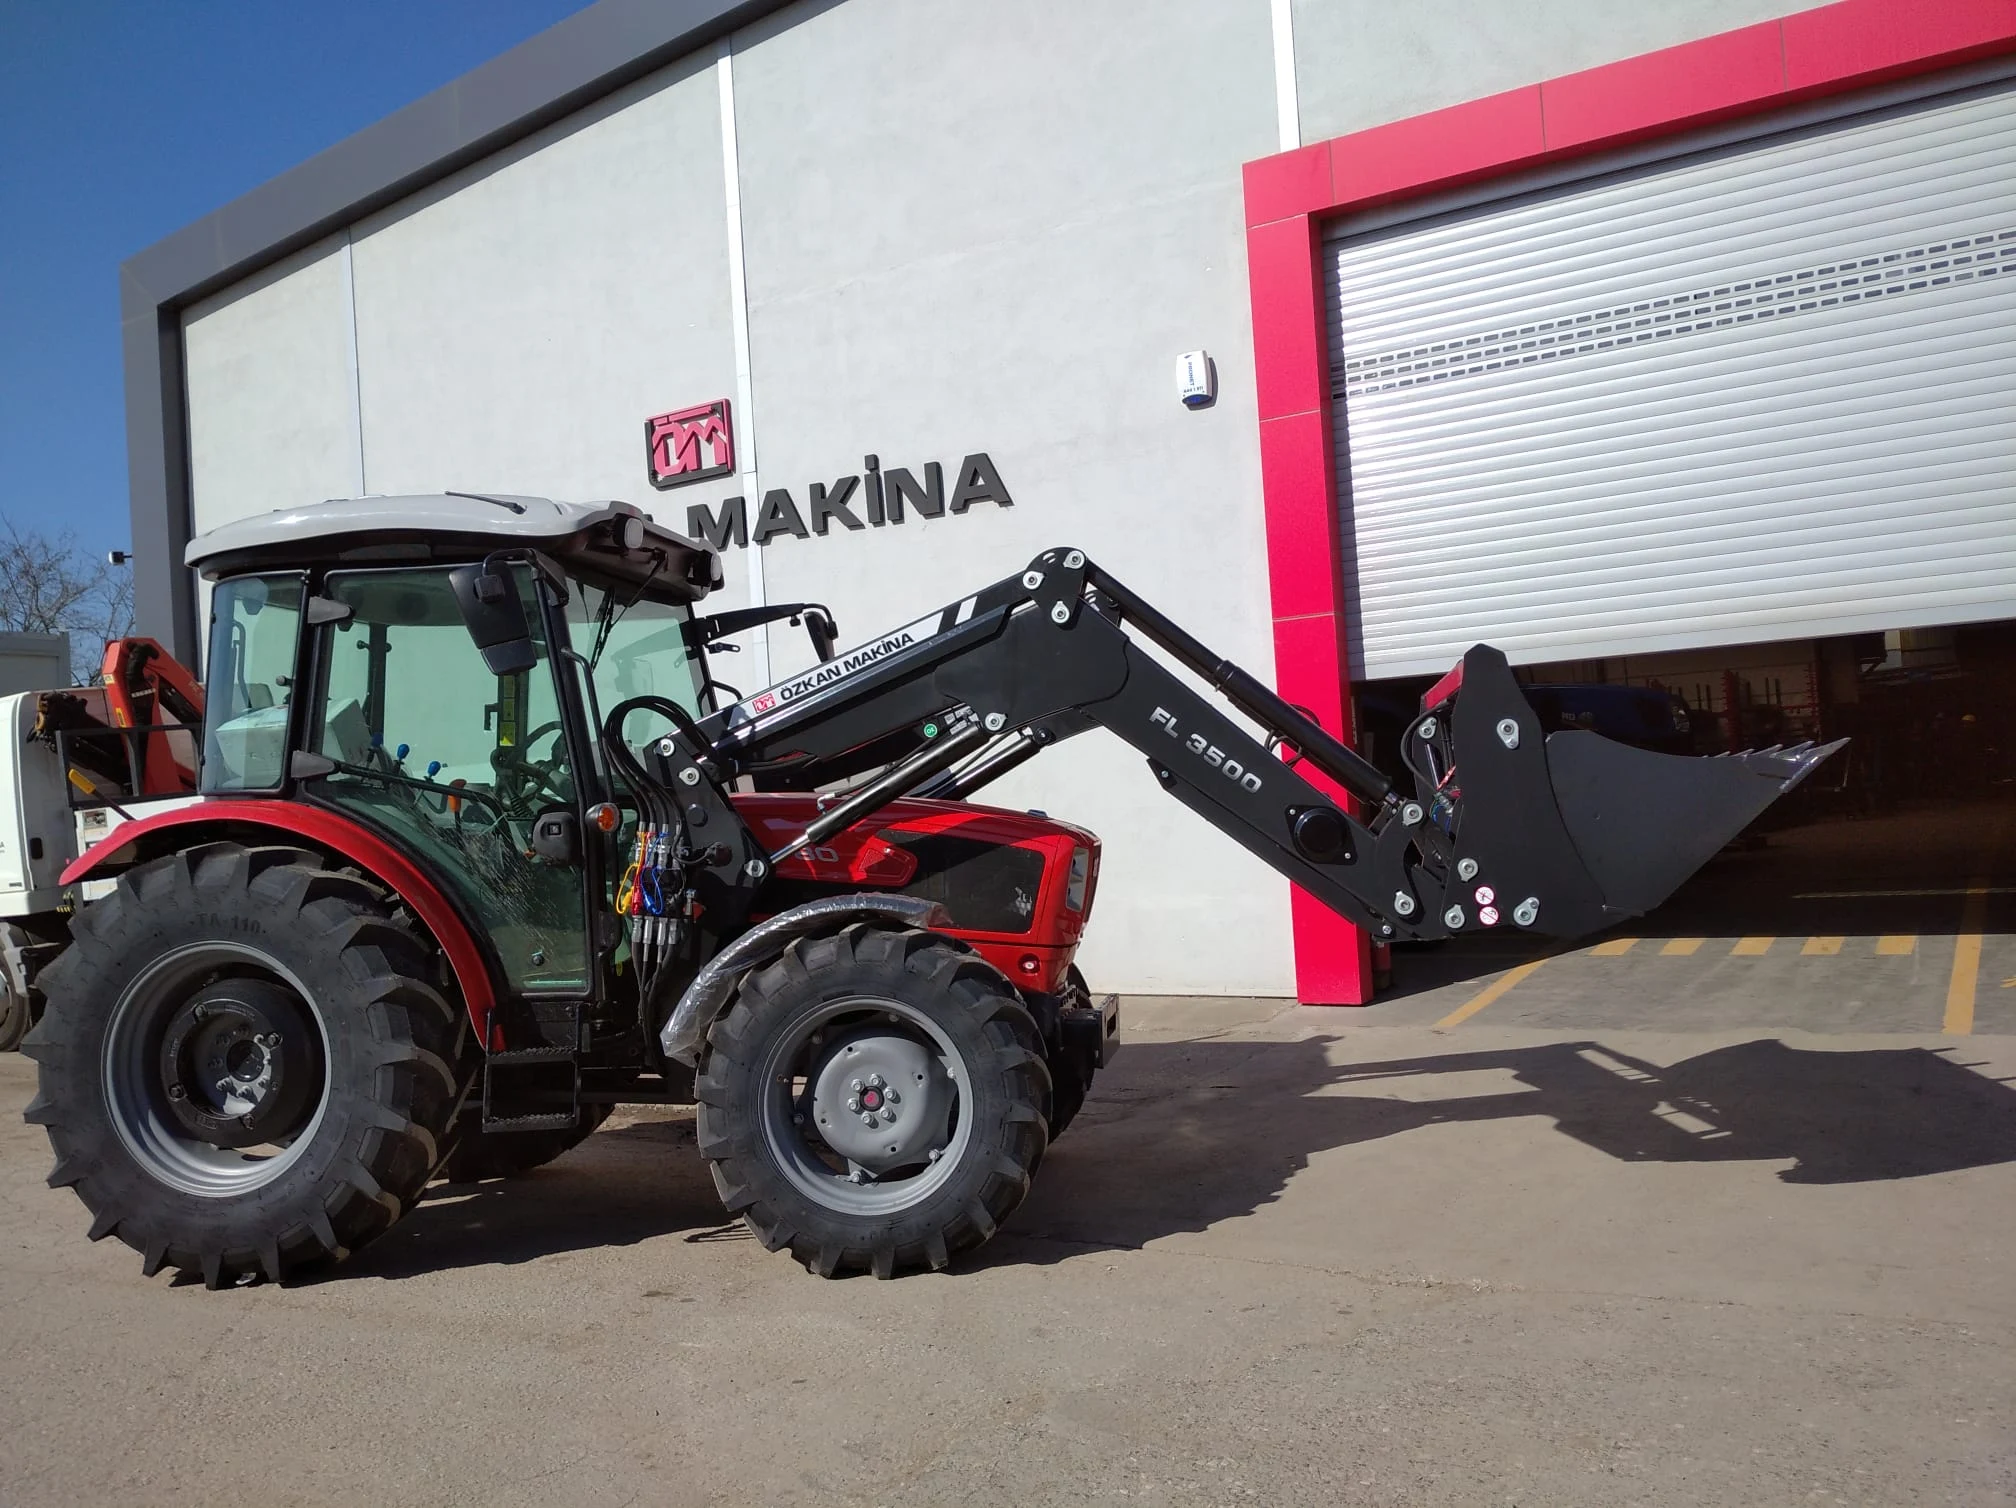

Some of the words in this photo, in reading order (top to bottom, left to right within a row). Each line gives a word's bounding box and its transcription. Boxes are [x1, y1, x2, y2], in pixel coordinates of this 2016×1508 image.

[686, 452, 1014, 551] MAKİNA
[780, 664, 841, 701] ÖZKAN
[843, 632, 915, 673] MAKİNA
[1149, 706, 1179, 738] FL
[1185, 733, 1263, 794] 3500
